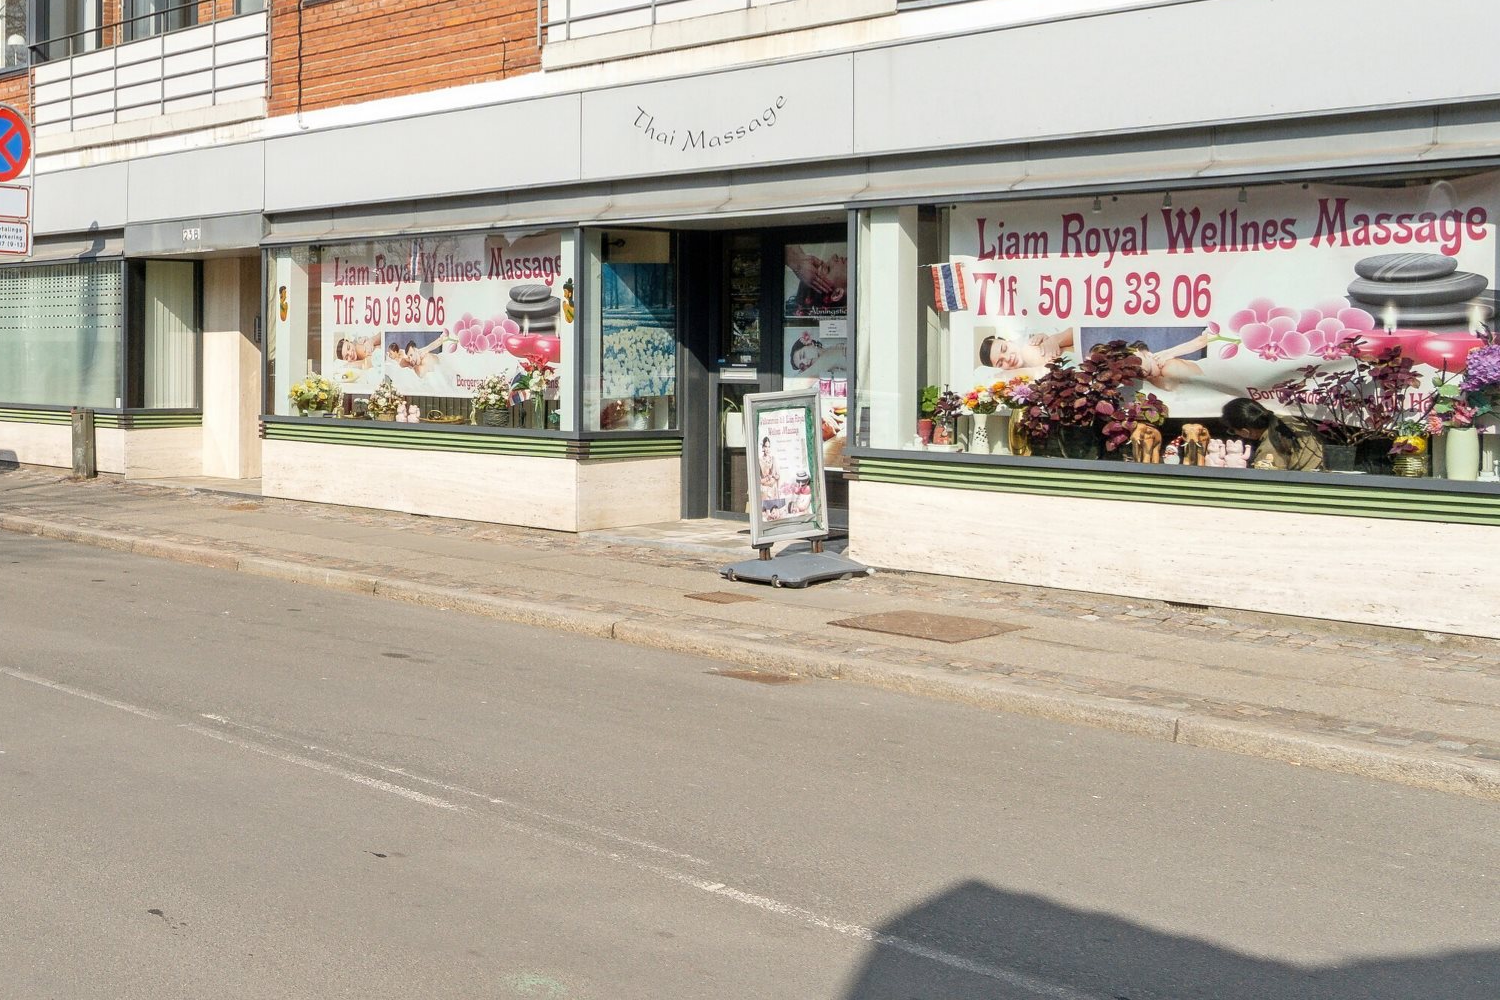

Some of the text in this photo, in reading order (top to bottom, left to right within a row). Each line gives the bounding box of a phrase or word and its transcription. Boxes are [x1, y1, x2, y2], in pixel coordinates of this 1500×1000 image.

[633, 95, 788, 152] Thai Massage
[976, 197, 1488, 268] Liam Royal Wellnes Massage
[333, 256, 370, 287] Liam
[419, 252, 481, 283] Wellnes
[333, 294, 445, 326] Tlf. 50 19 33 06
[973, 272, 1212, 320] Tlf. 50 19 33 06
